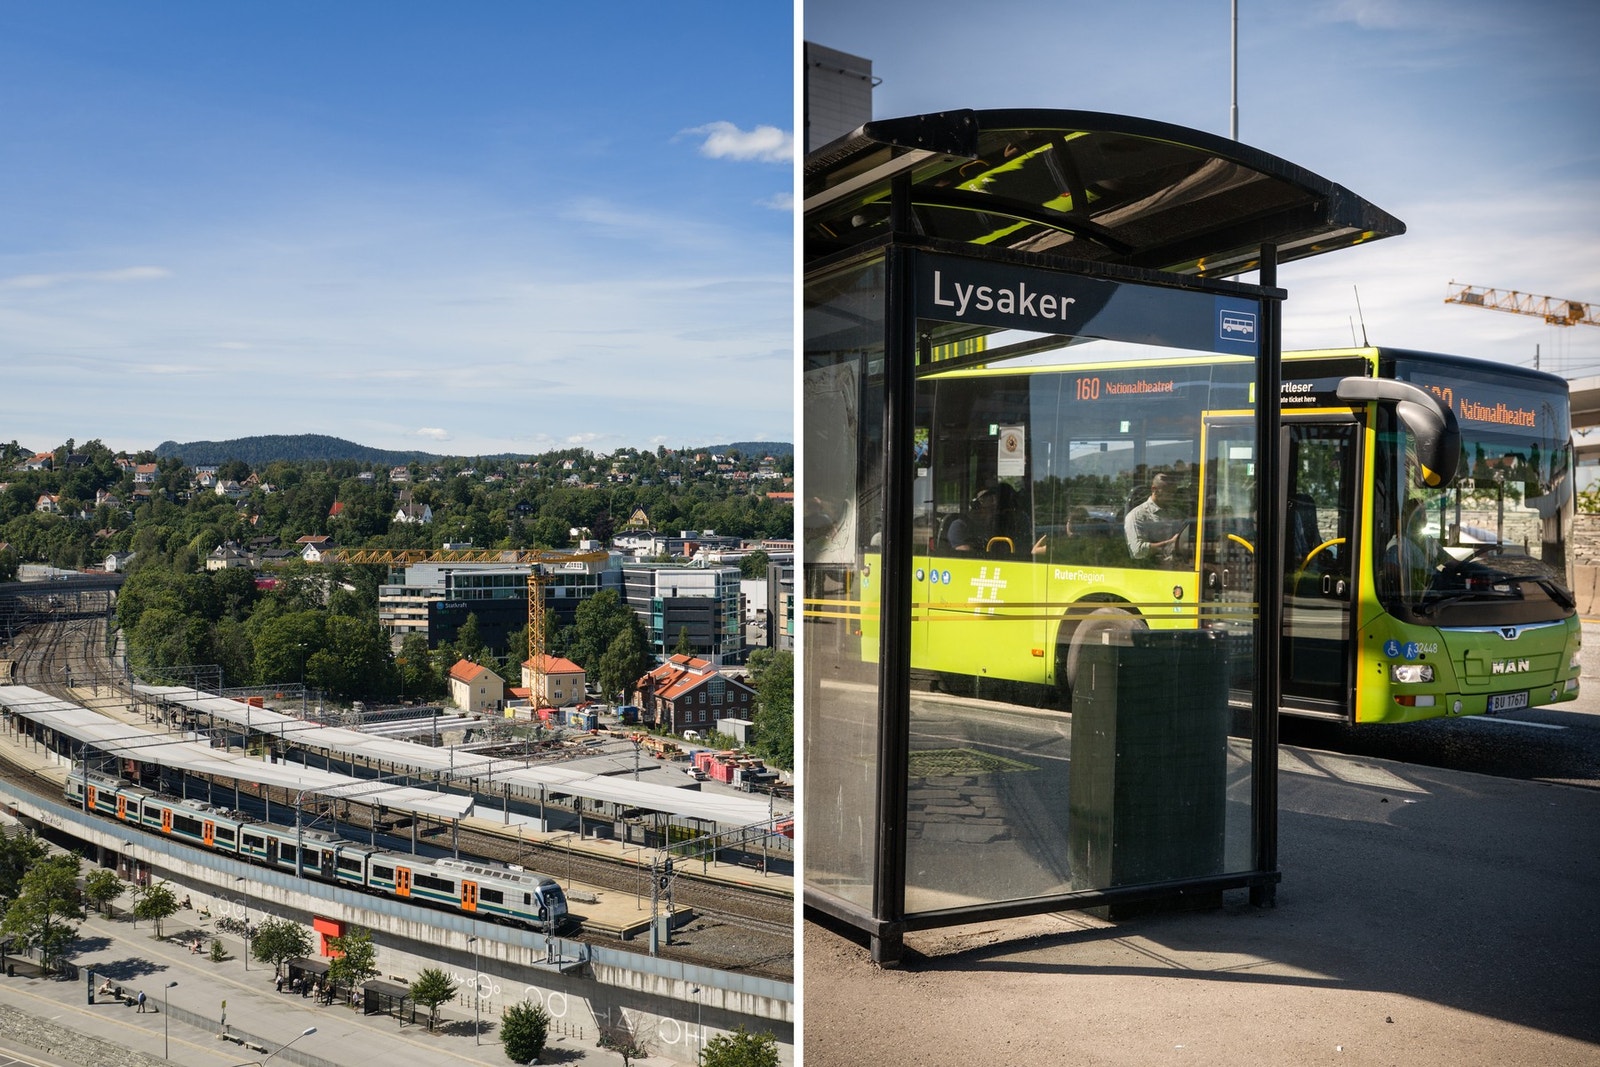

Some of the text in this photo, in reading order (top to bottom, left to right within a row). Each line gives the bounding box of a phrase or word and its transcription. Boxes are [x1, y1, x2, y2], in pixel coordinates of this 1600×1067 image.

[934, 270, 1076, 321] Lysaker
[1076, 377, 1174, 400] 160 Nationaltheatret
[1289, 395, 1303, 403] ticket
[1460, 398, 1536, 427] Nationaltheatret
[1054, 568, 1105, 585] RuterRegion
[1413, 642, 1438, 654] 32448
[1492, 660, 1530, 674] MAN
[1494, 693, 1527, 709] BU 17671
